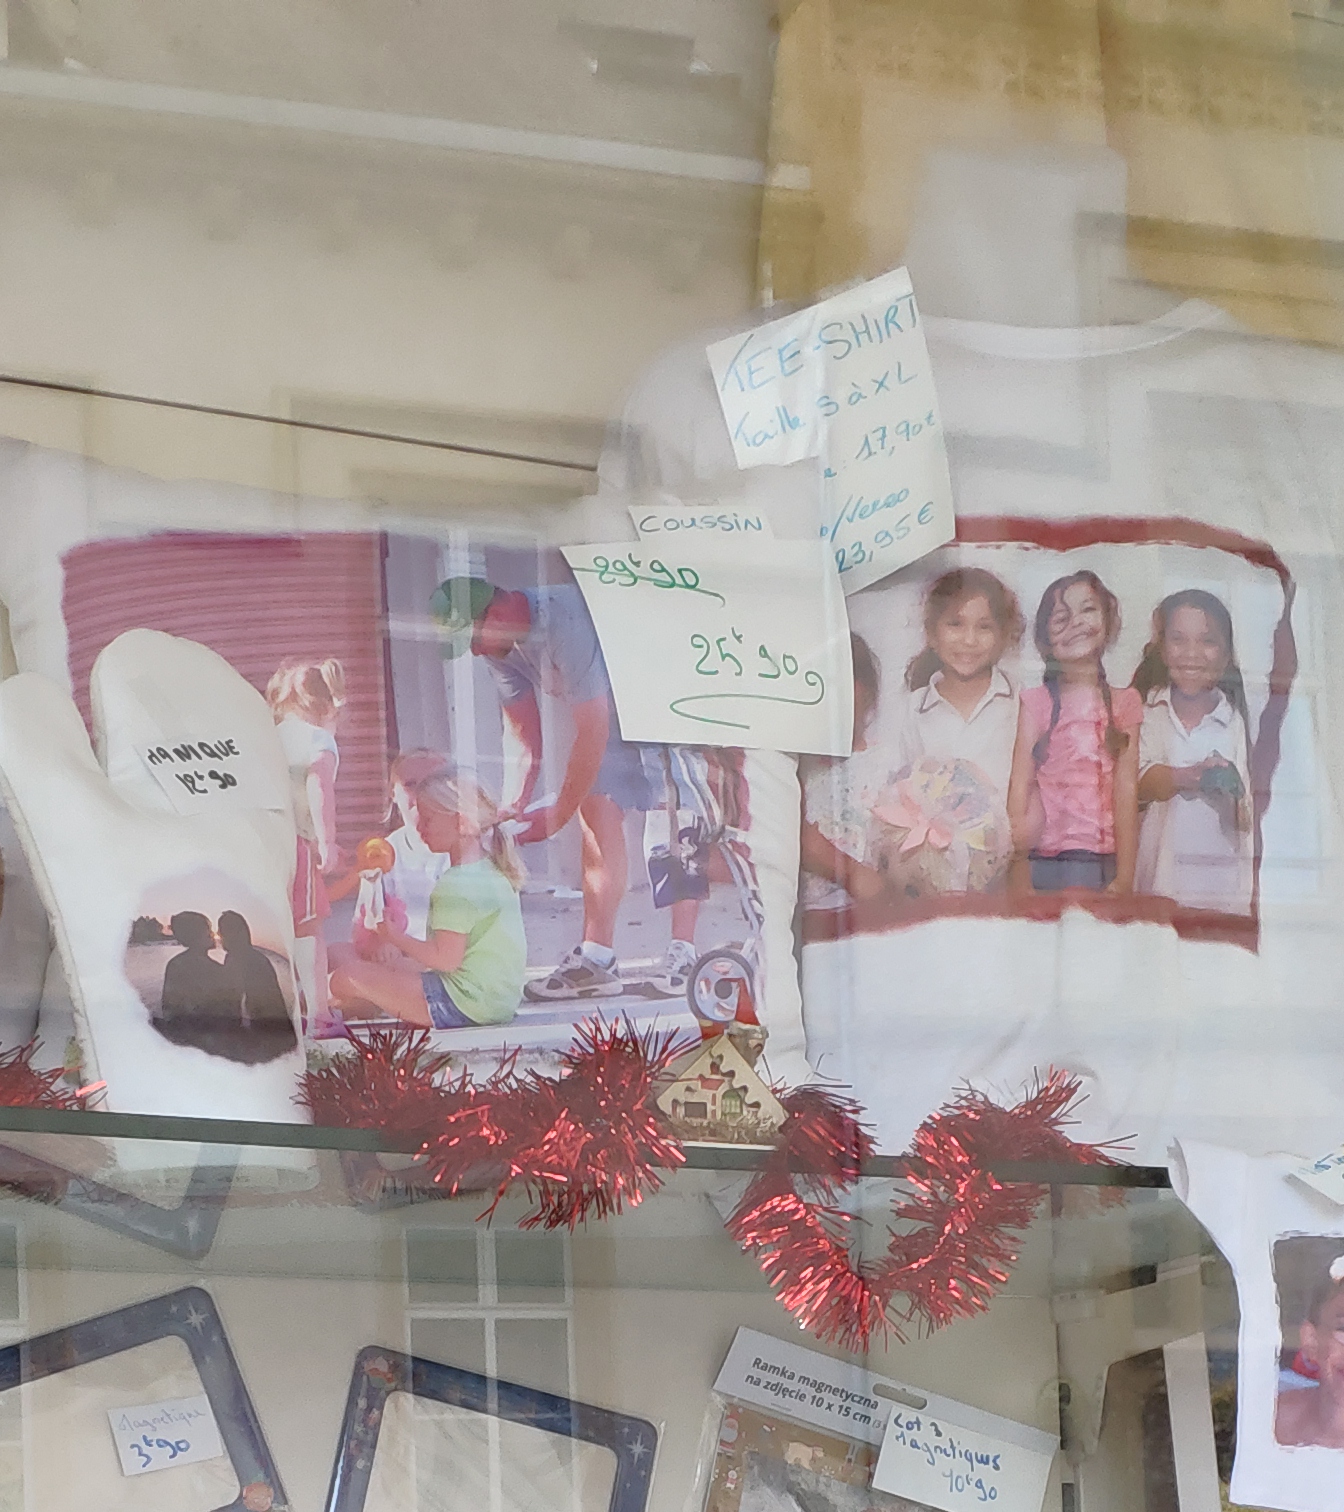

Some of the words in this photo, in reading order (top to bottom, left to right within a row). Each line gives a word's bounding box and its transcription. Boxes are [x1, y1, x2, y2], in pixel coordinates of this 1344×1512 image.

[146, 738, 241, 766] MANIQUE
[744, 1374, 762, 1387] na
[763, 1380, 807, 1403] zdjęcie
[810, 1395, 825, 1408] 10
[837, 1404, 852, 1418] 15
[852, 1412, 872, 1425] cm
[752, 1357, 796, 1381] Ramka
[798, 1374, 879, 1410] magnetyczna
